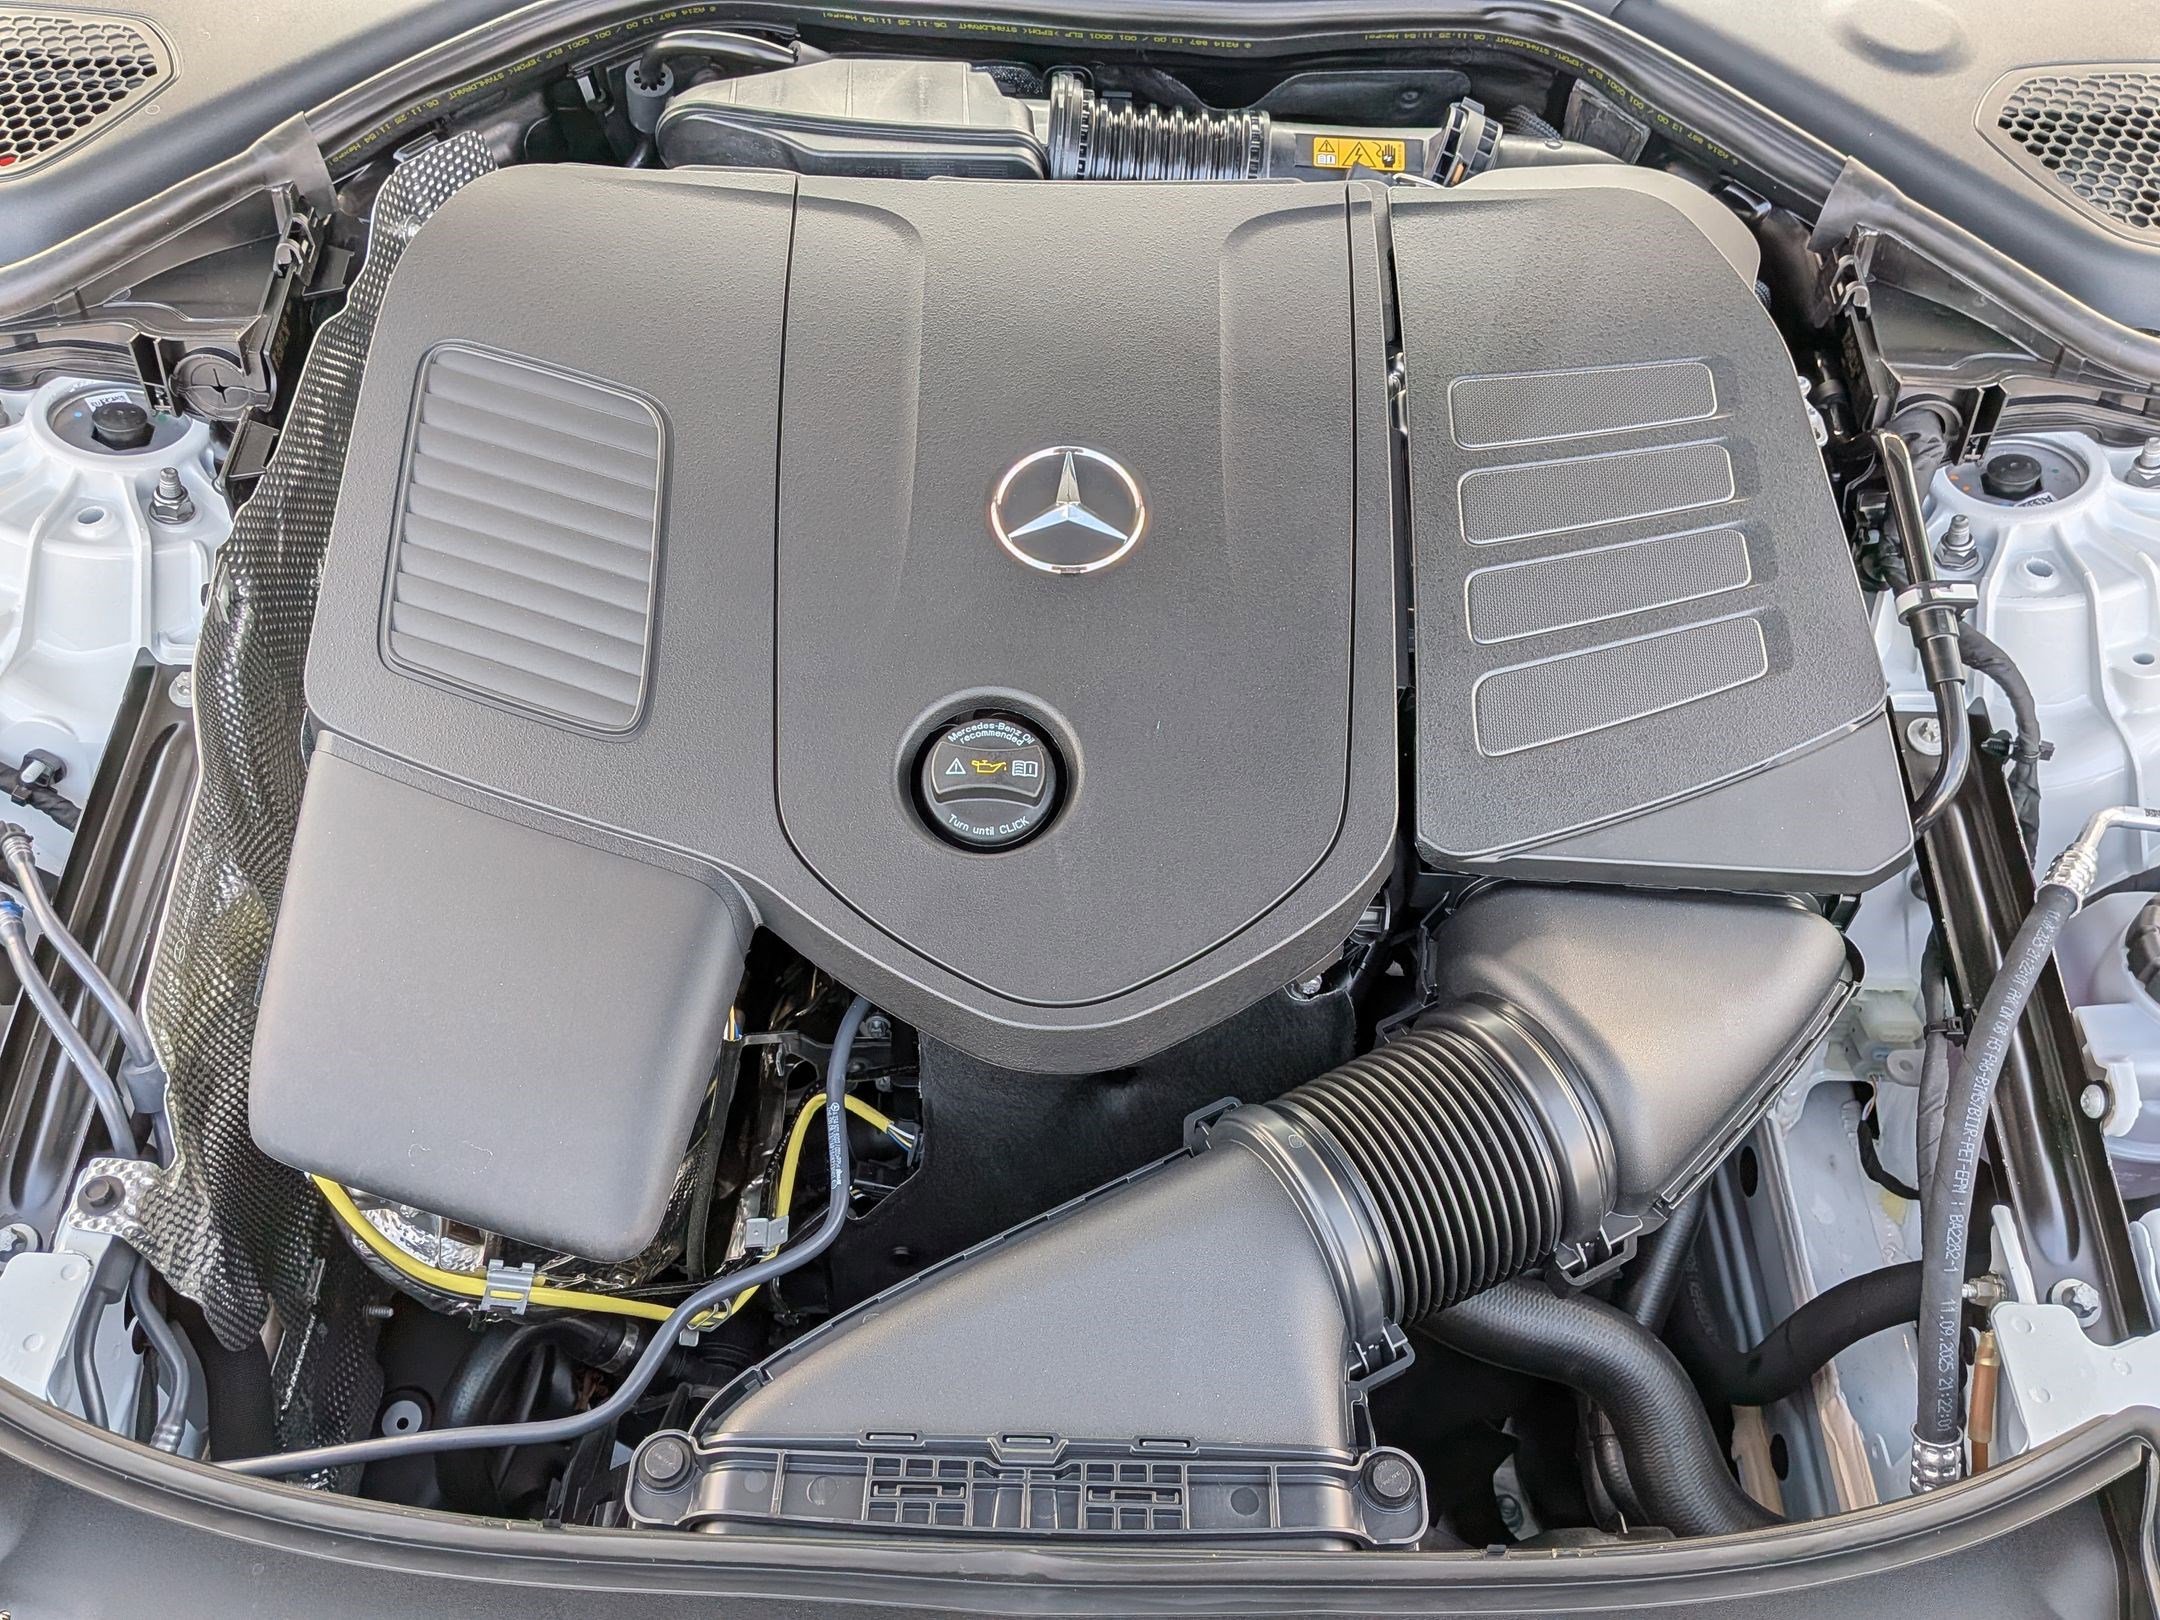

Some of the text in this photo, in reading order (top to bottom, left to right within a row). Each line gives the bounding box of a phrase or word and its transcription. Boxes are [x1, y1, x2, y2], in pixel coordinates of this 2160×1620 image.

[449, 73, 504, 100] STAHLDRAHT
[948, 722, 1036, 745] Mercedes-Benz Oil
[960, 730, 1025, 747] recommended
[948, 814, 1030, 836] Turn until CLICK
[1937, 1298, 1957, 1371] 11.09.2025
[1936, 1376, 1953, 1432] 21:22:01
